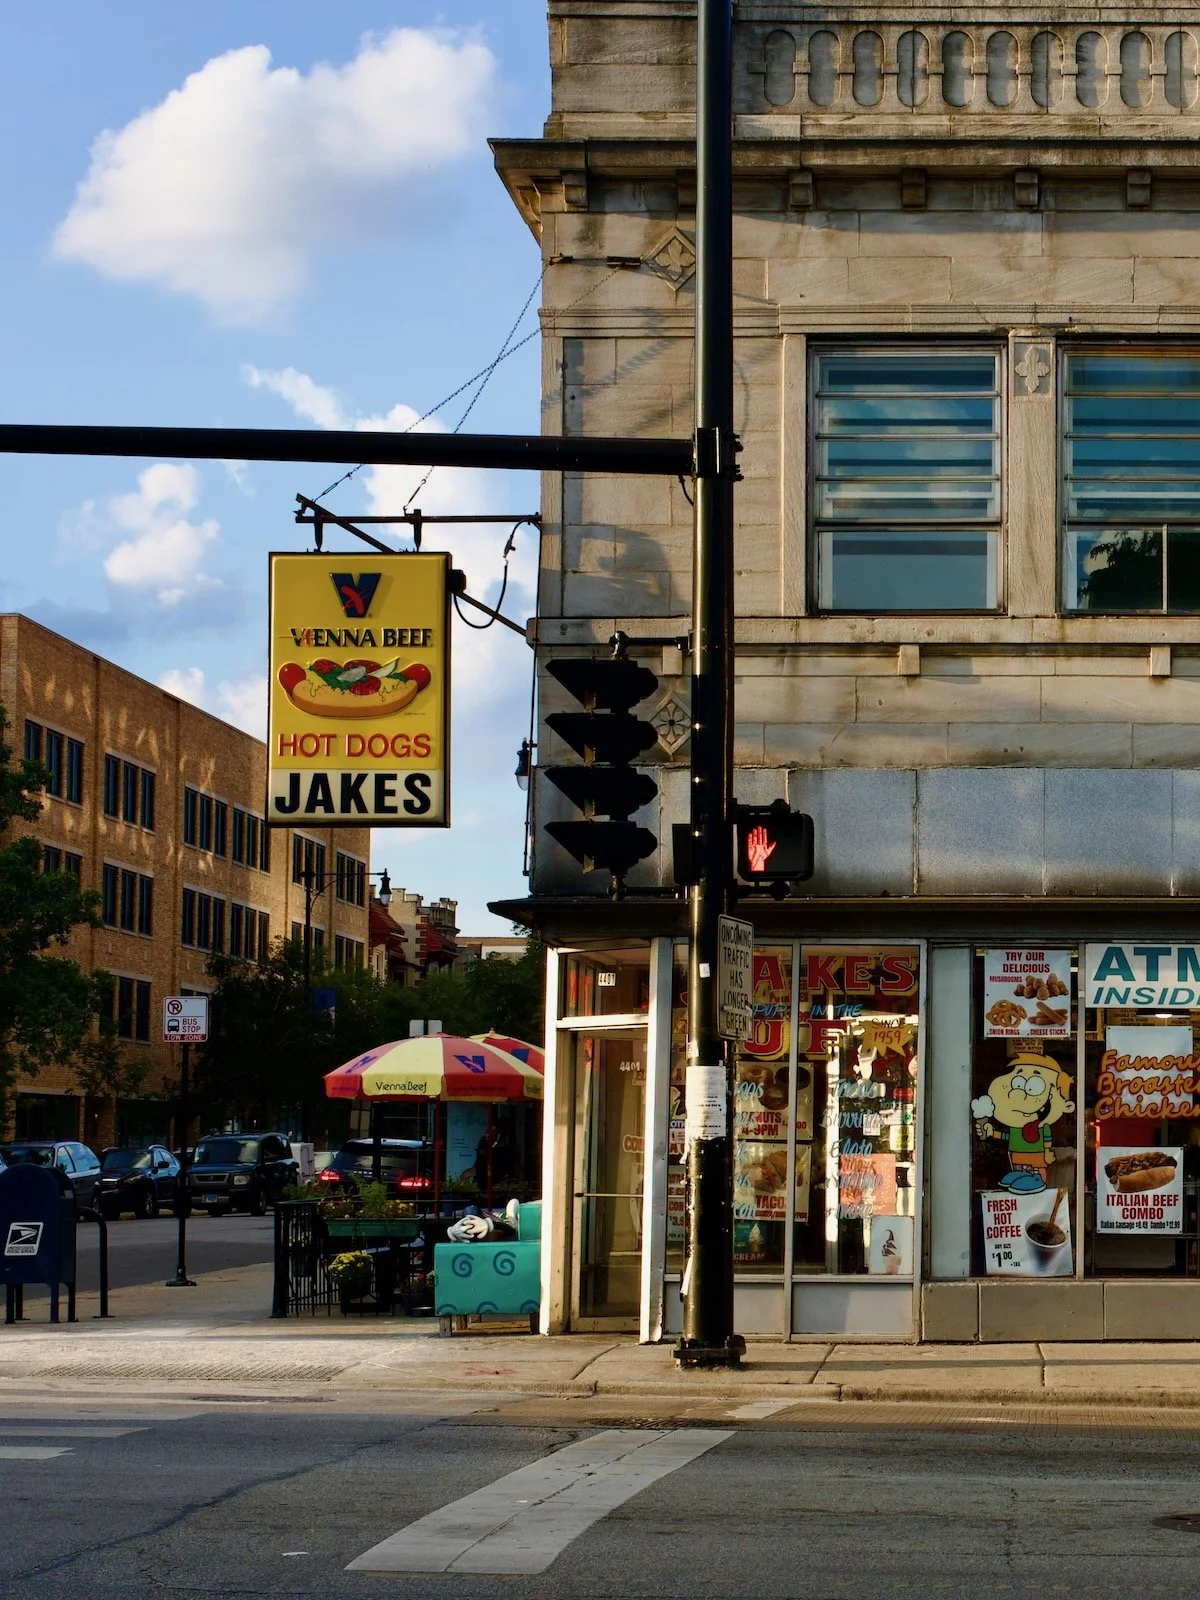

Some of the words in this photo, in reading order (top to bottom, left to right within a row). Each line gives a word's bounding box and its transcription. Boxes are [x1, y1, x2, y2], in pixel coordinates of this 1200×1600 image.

[382, 628, 433, 647] BEEF
[278, 733, 337, 757] HOT
[346, 733, 431, 758] DOGS
[275, 772, 432, 815] JAKES
[721, 925, 752, 948] ONCOMING
[723, 947, 750, 969] TRAFFIC
[1005, 951, 1022, 961] TRY
[1025, 951, 1045, 961] OUR
[1002, 963, 1050, 973] DELICIOUS
[729, 969, 743, 988] HAS
[723, 990, 748, 1011] LONGER
[810, 1003, 827, 1016] IN
[835, 1003, 864, 1016] THE
[182, 1018, 198, 1026] BUS
[725, 1011, 747, 1031] GREEN
[873, 1030, 902, 1045] 1959
[1005, 1028, 1020, 1036] RINGS
[375, 1082, 407, 1091] Vienna
[987, 1199, 1017, 1212] FRESH
[1106, 1194, 1149, 1206] ITALIAN
[1152, 1194, 1179, 1206] BEEF
[994, 1212, 1012, 1225] HOT
[1122, 1207, 1164, 1220] COMBO
[986, 1225, 1022, 1239] COFFEE
